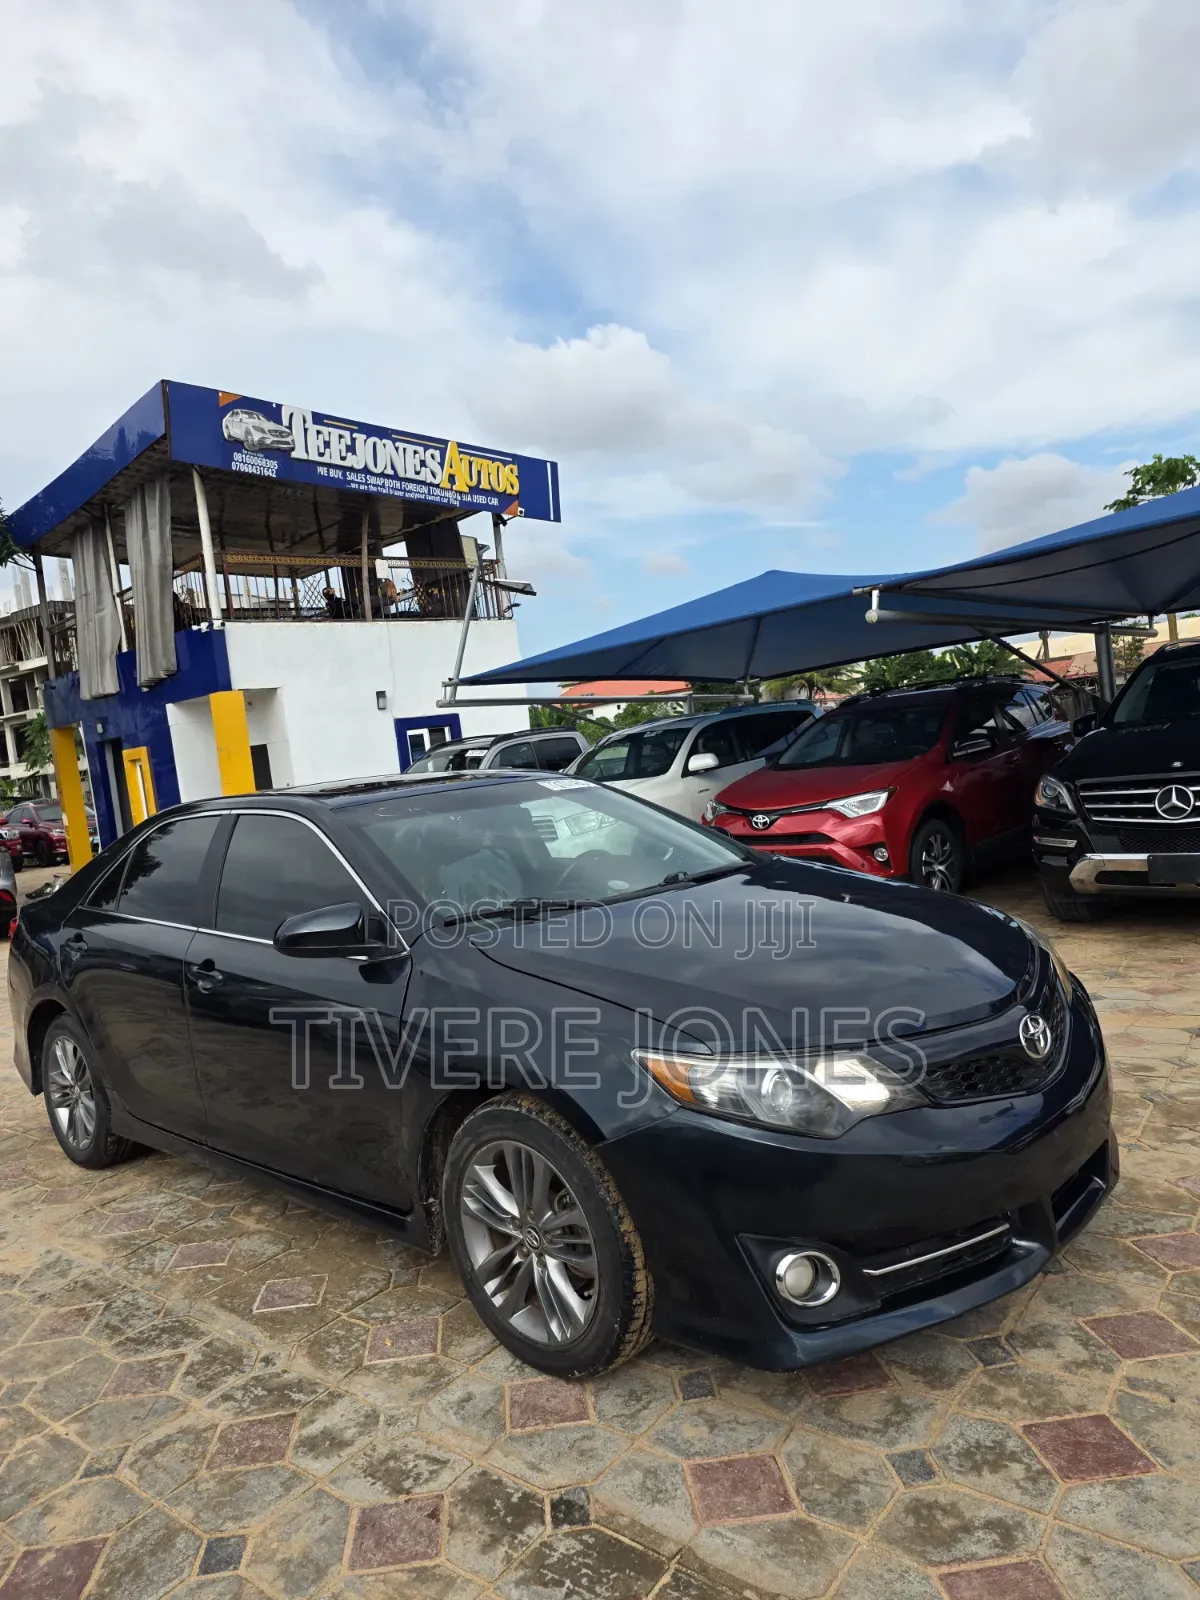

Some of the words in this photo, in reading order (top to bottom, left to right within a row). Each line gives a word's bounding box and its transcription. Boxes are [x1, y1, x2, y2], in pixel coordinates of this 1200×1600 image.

[282, 405, 441, 484] TEEJONES
[440, 441, 519, 495] AUTOS
[317, 466, 328, 476] WE
[346, 472, 365, 482] SALES
[367, 475, 384, 485] SWAP
[385, 479, 400, 489] BOTH
[430, 487, 456, 498] TOKUNBO
[473, 495, 487, 503] USED
[488, 497, 499, 505] CAR
